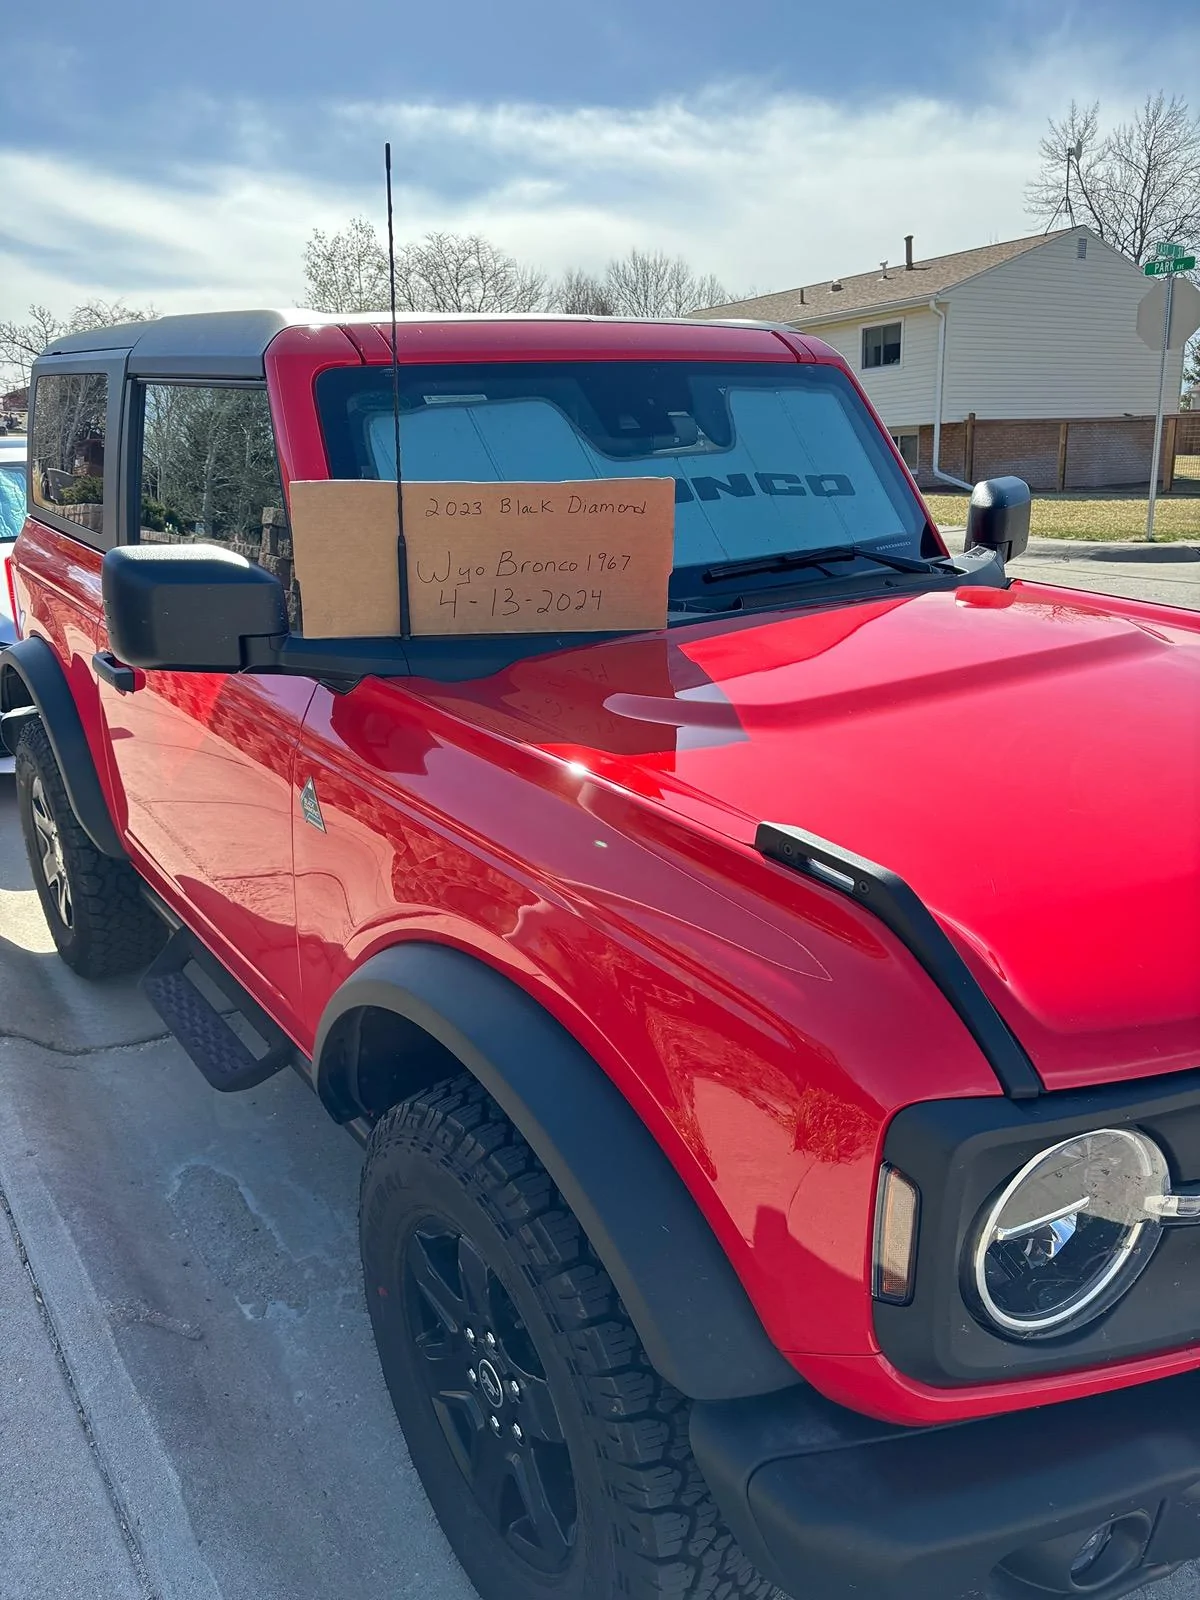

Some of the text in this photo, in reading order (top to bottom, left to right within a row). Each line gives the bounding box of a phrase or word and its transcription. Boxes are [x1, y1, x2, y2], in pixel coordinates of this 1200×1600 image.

[1154, 260, 1174, 273] PARK
[425, 498, 482, 517] 2023
[567, 495, 646, 515] Diamond
[416, 551, 484, 585] Wyo
